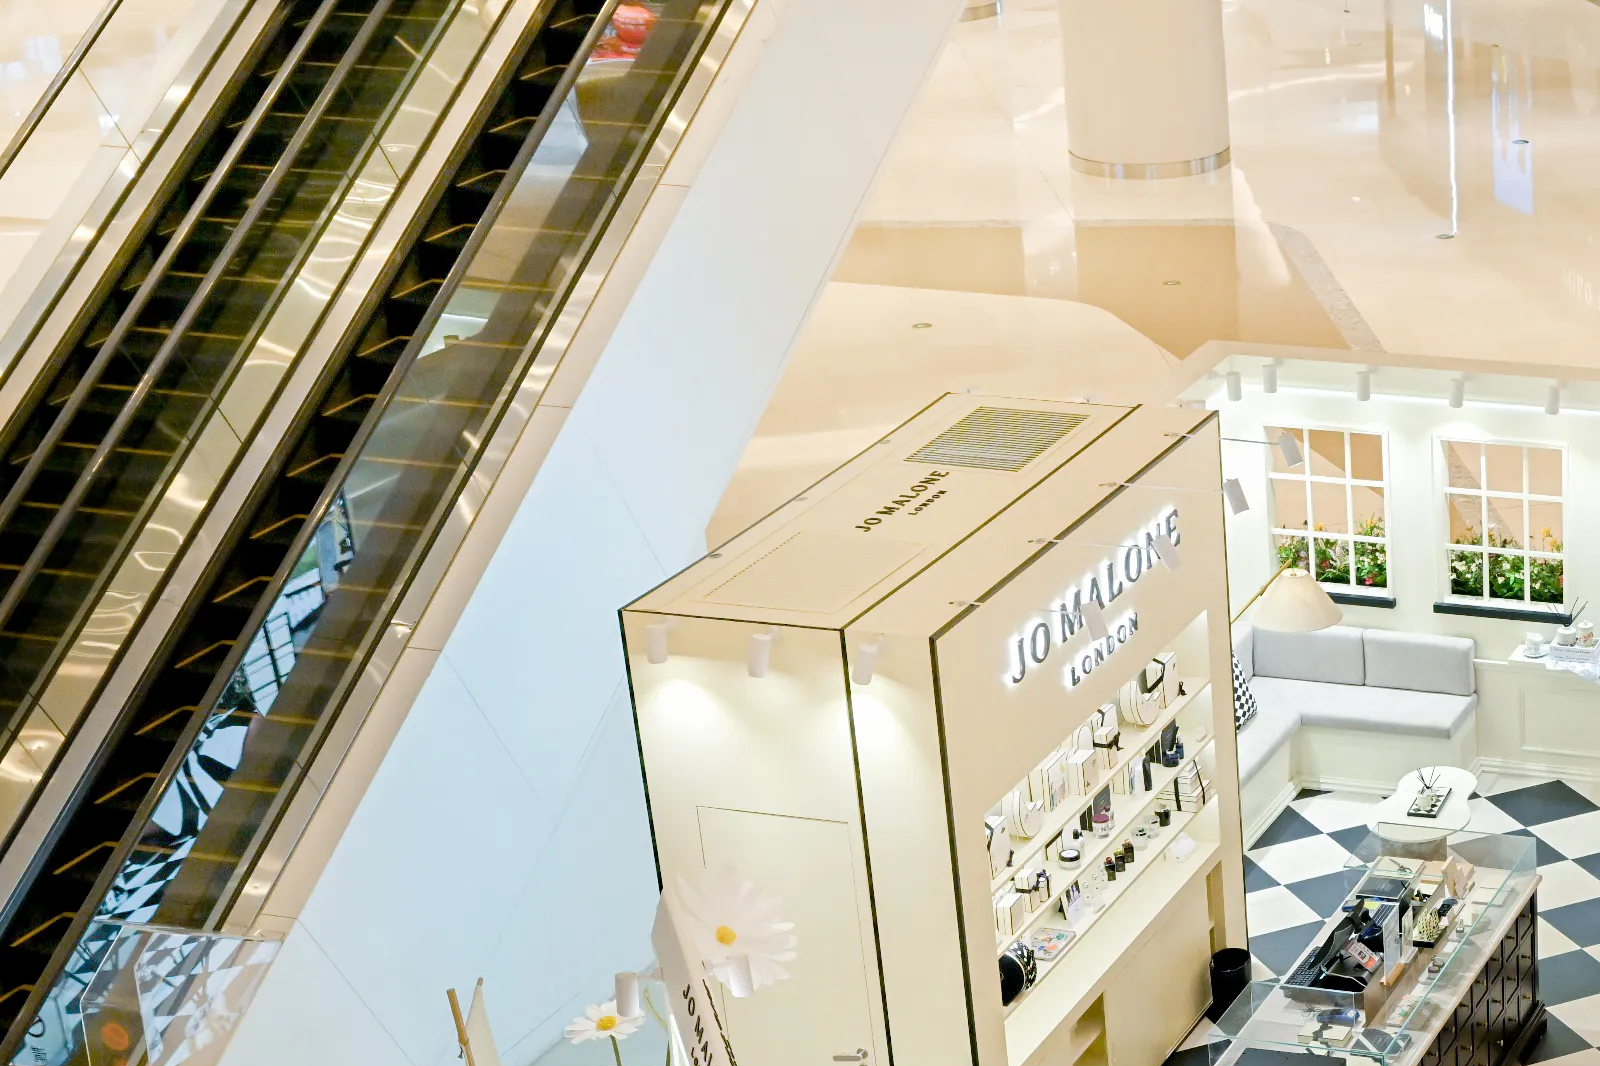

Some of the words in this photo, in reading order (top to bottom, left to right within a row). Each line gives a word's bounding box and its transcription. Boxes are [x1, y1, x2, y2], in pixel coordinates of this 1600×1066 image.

[855, 517, 882, 532] JO
[875, 470, 950, 516] MALONE
[907, 490, 948, 516] LONDON
[1012, 622, 1051, 684] JO
[1060, 509, 1181, 643] MALONE
[1070, 612, 1139, 687] LONDON
[683, 984, 696, 1017] JO
